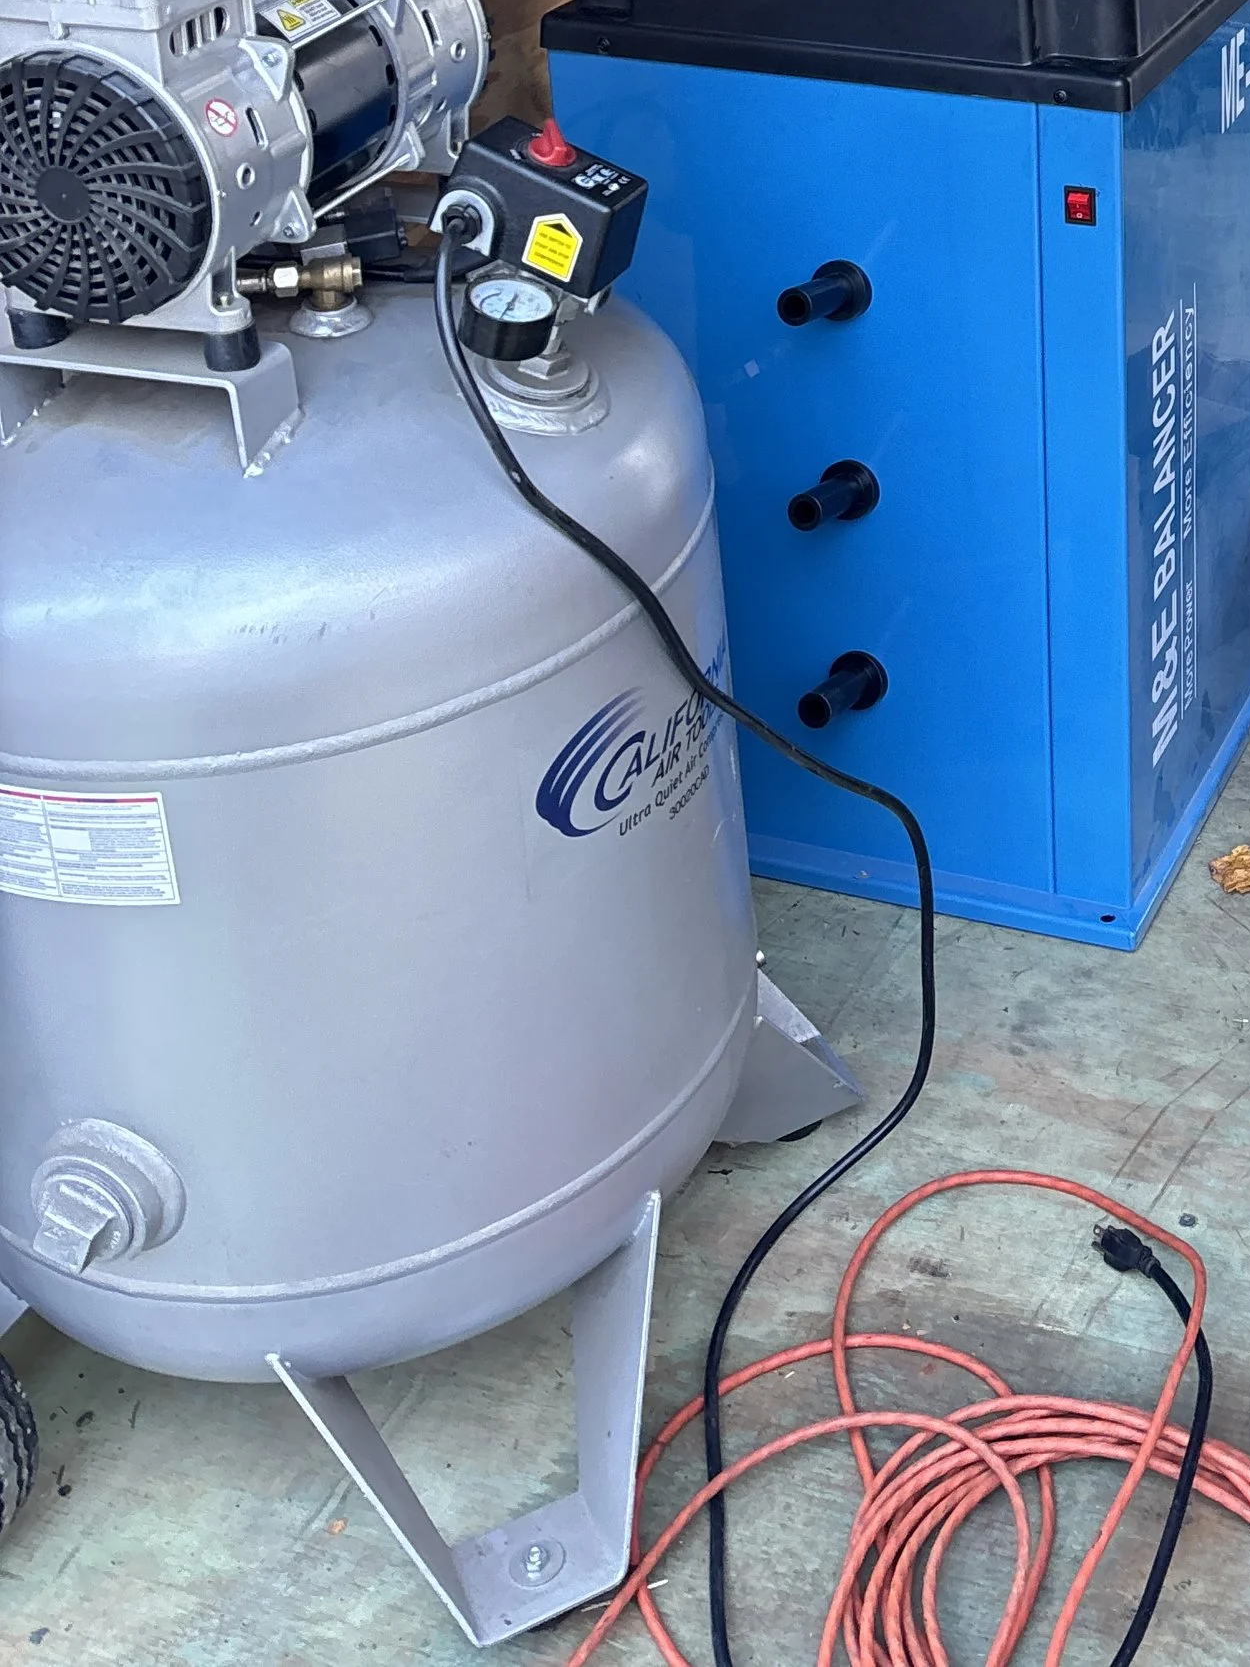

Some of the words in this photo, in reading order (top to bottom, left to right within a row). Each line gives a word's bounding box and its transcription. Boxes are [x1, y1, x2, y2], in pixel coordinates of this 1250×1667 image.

[1183, 306, 1195, 464] Efficiency
[1153, 309, 1176, 602] BALANCER
[1183, 467, 1193, 540] More
[1152, 588, 1178, 769] M&E
[619, 803, 652, 837] Ultra
[654, 770, 684, 808] Quiet
[684, 753, 698, 779] Air
[651, 741, 682, 789] AIR
[686, 700, 718, 752] TOOL
